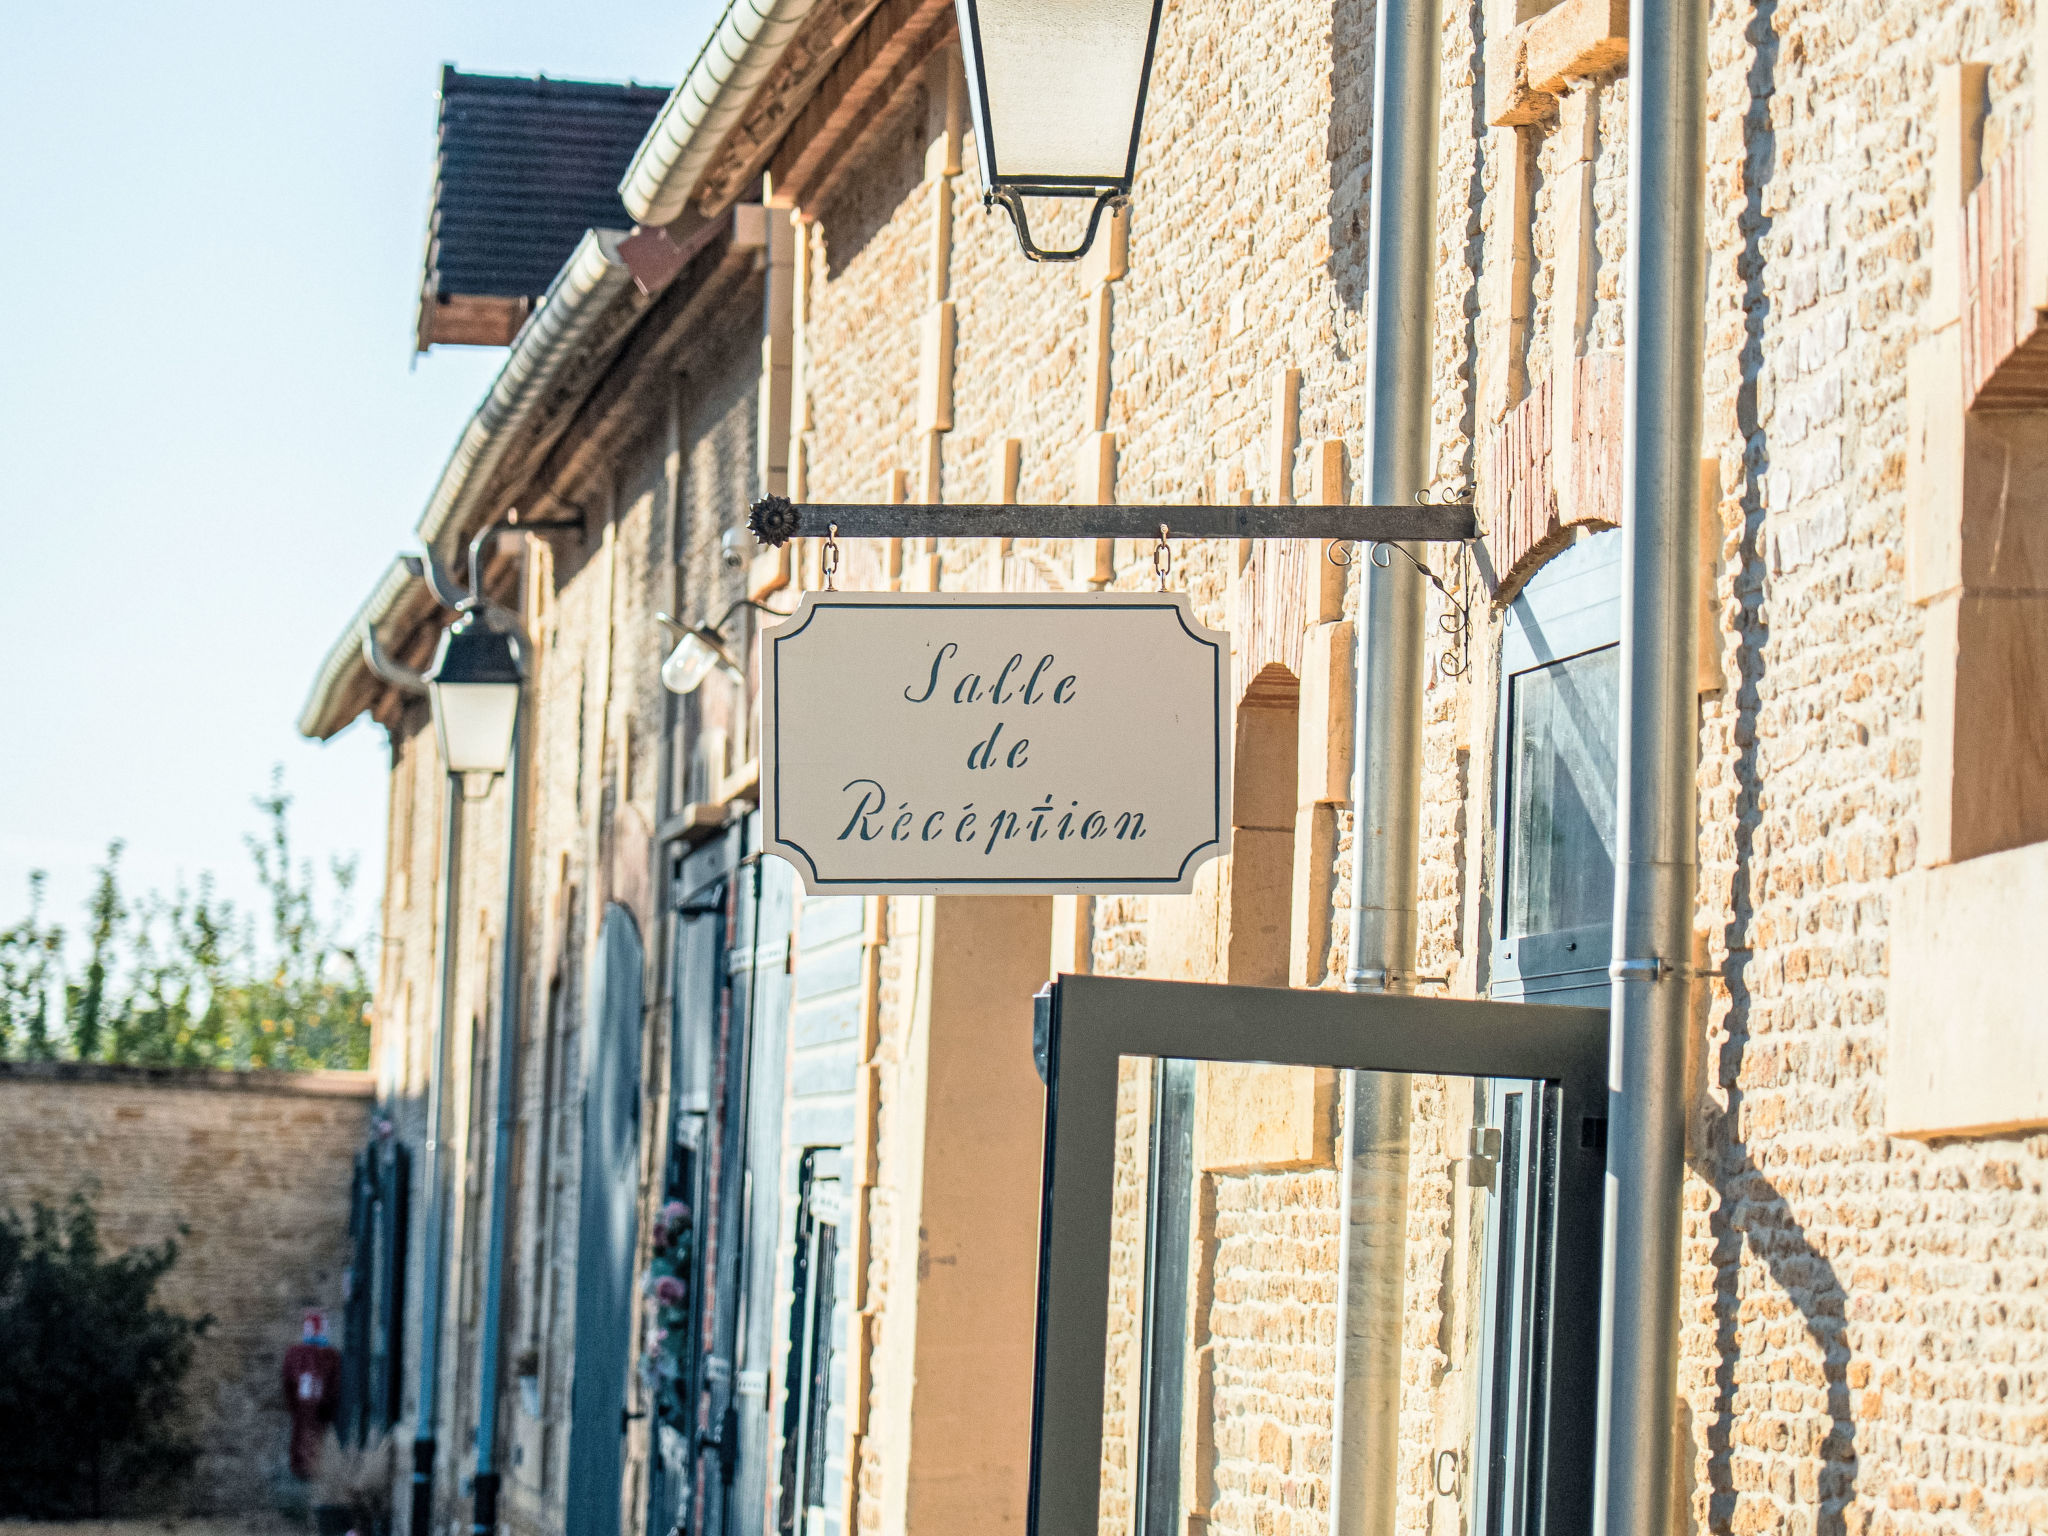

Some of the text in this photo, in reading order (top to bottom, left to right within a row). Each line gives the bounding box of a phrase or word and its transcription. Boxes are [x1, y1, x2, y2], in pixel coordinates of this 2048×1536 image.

[904, 642, 1076, 705] Salle
[966, 722, 1030, 770] de
[836, 779, 1147, 855] Récéption
